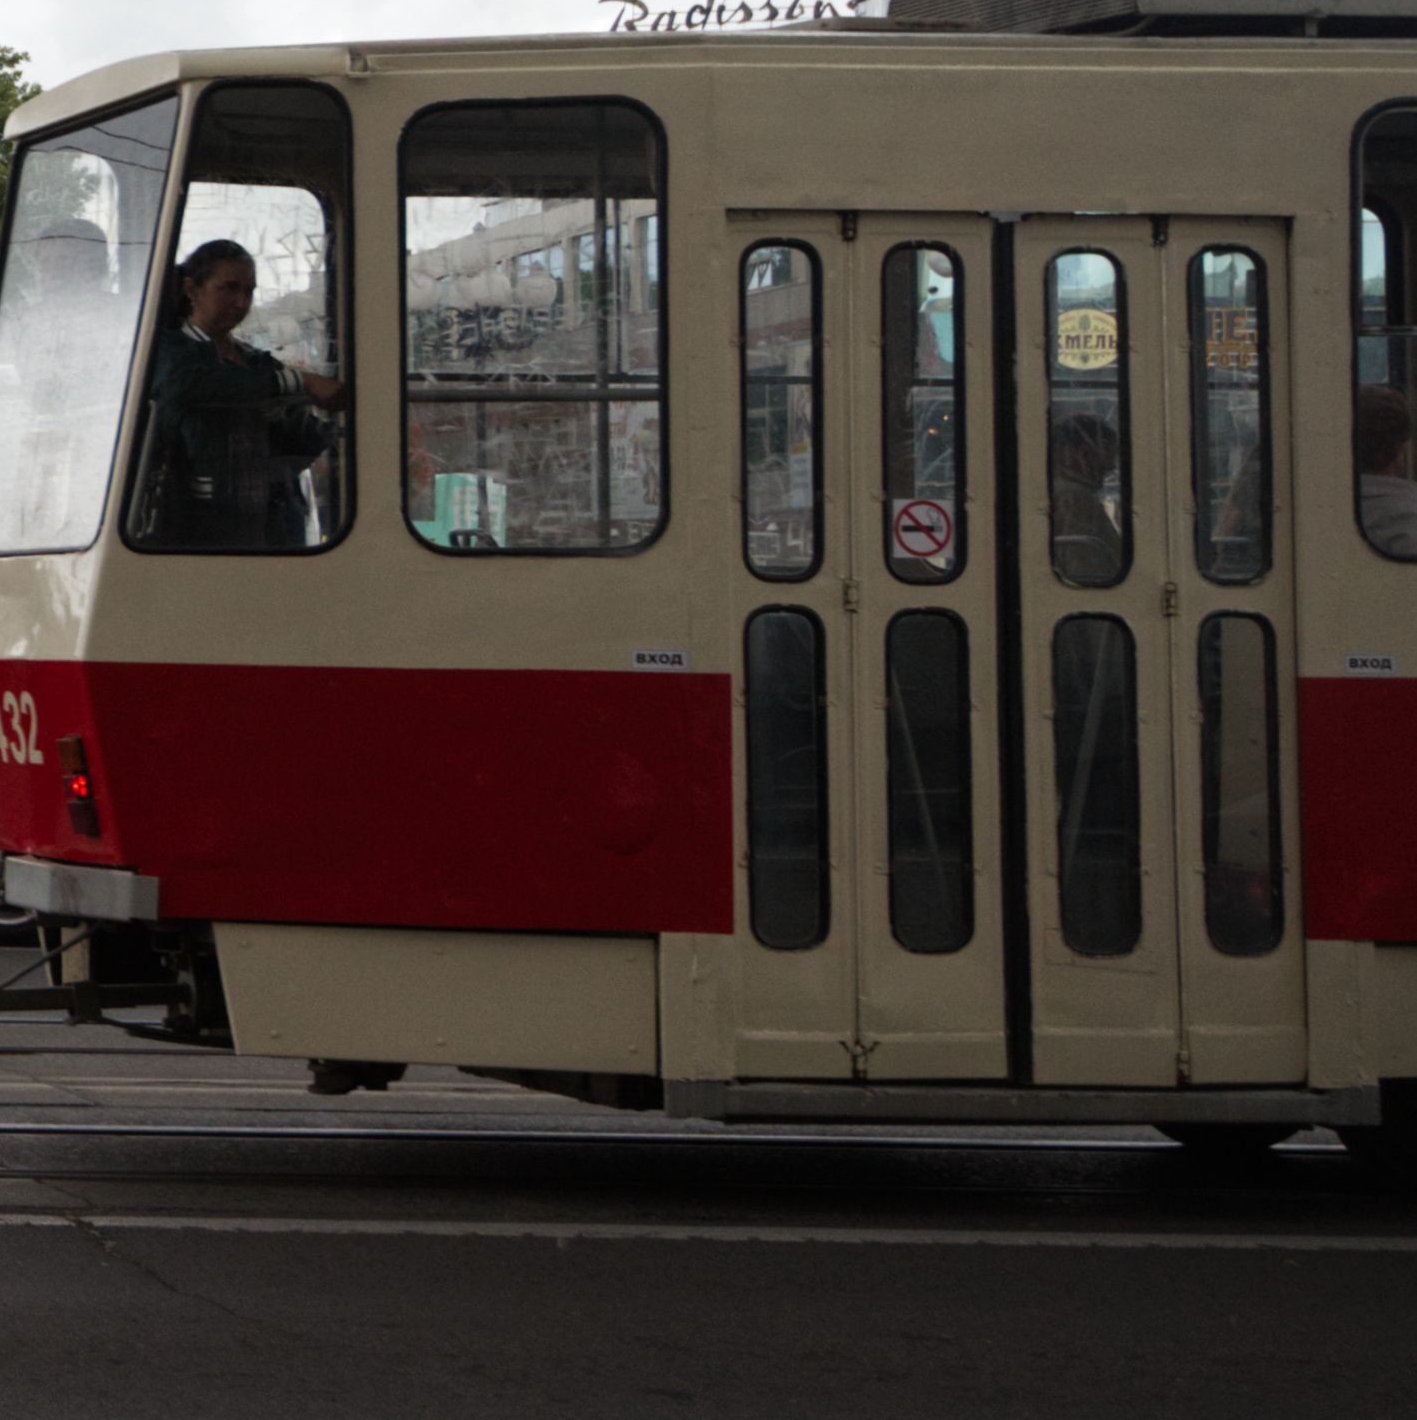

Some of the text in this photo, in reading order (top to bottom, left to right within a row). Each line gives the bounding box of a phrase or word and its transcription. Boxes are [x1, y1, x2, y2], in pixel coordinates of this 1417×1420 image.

[1057, 334, 1117, 350] МЕЛЬ
[636, 653, 684, 666] ВХОД
[1349, 658, 1392, 670] ВХОД
